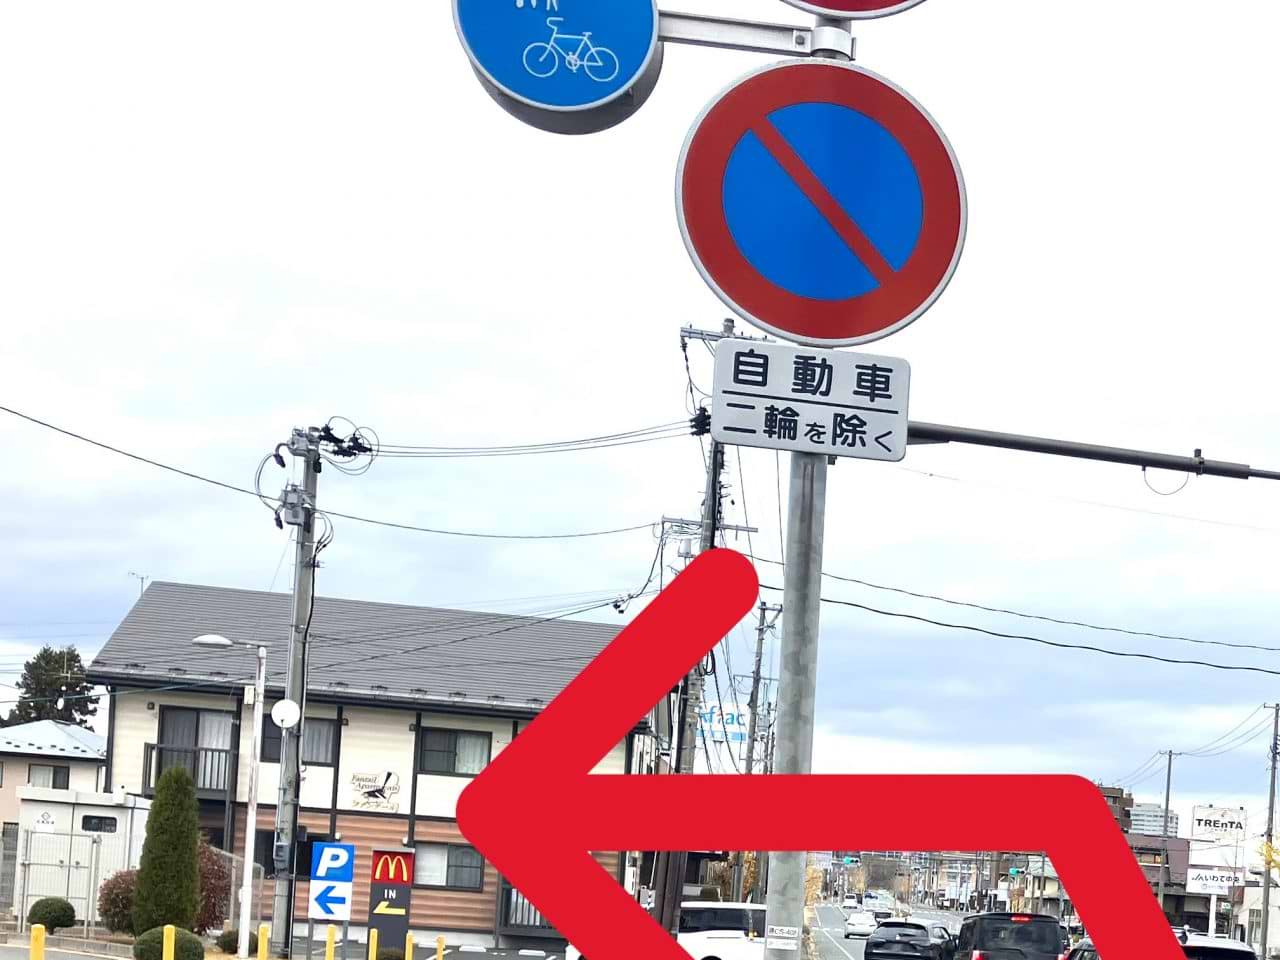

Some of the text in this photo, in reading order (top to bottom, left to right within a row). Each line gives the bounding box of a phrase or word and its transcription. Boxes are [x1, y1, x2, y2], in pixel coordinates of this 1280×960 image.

[733, 349, 893, 402] 自動車
[723, 403, 892, 453] 二輪を除く
[315, 847, 349, 877] P
[384, 888, 397, 899] IN
